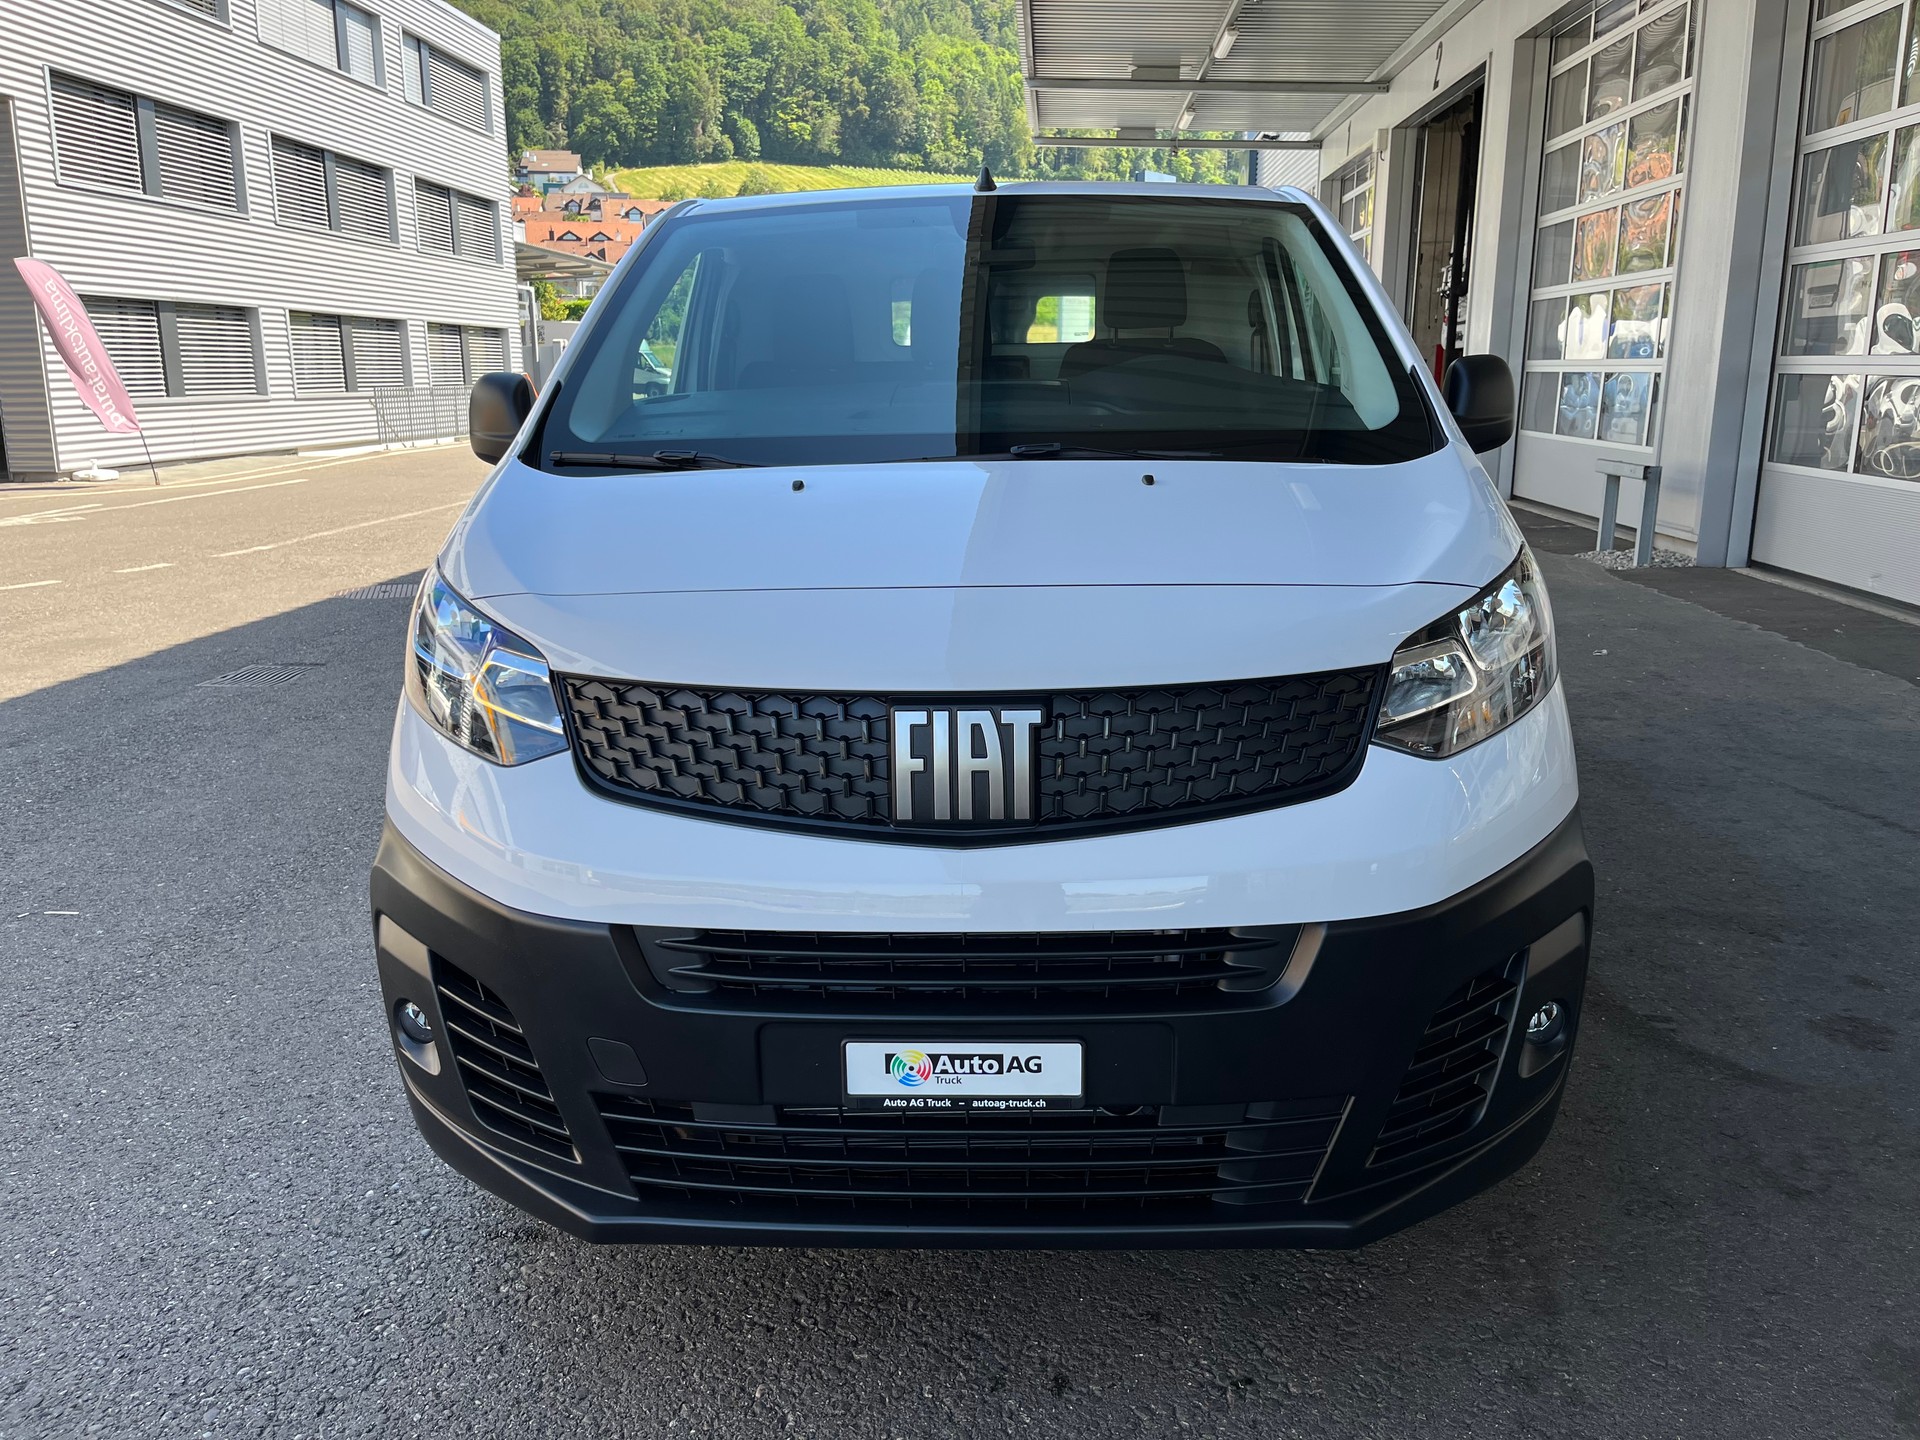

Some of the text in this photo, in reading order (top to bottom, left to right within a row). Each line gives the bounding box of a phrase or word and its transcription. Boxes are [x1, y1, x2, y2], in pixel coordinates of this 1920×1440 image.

[1433, 41, 1443, 91] 2
[894, 710, 1042, 820] FIAT
[934, 1055, 1042, 1074] Auto AG
[935, 1076, 962, 1085] Truck
[884, 1099, 907, 1107] Auto
[910, 1099, 924, 1107] AG
[927, 1099, 951, 1107] Truck
[972, 1099, 1046, 1109] autoag-truck.ch
